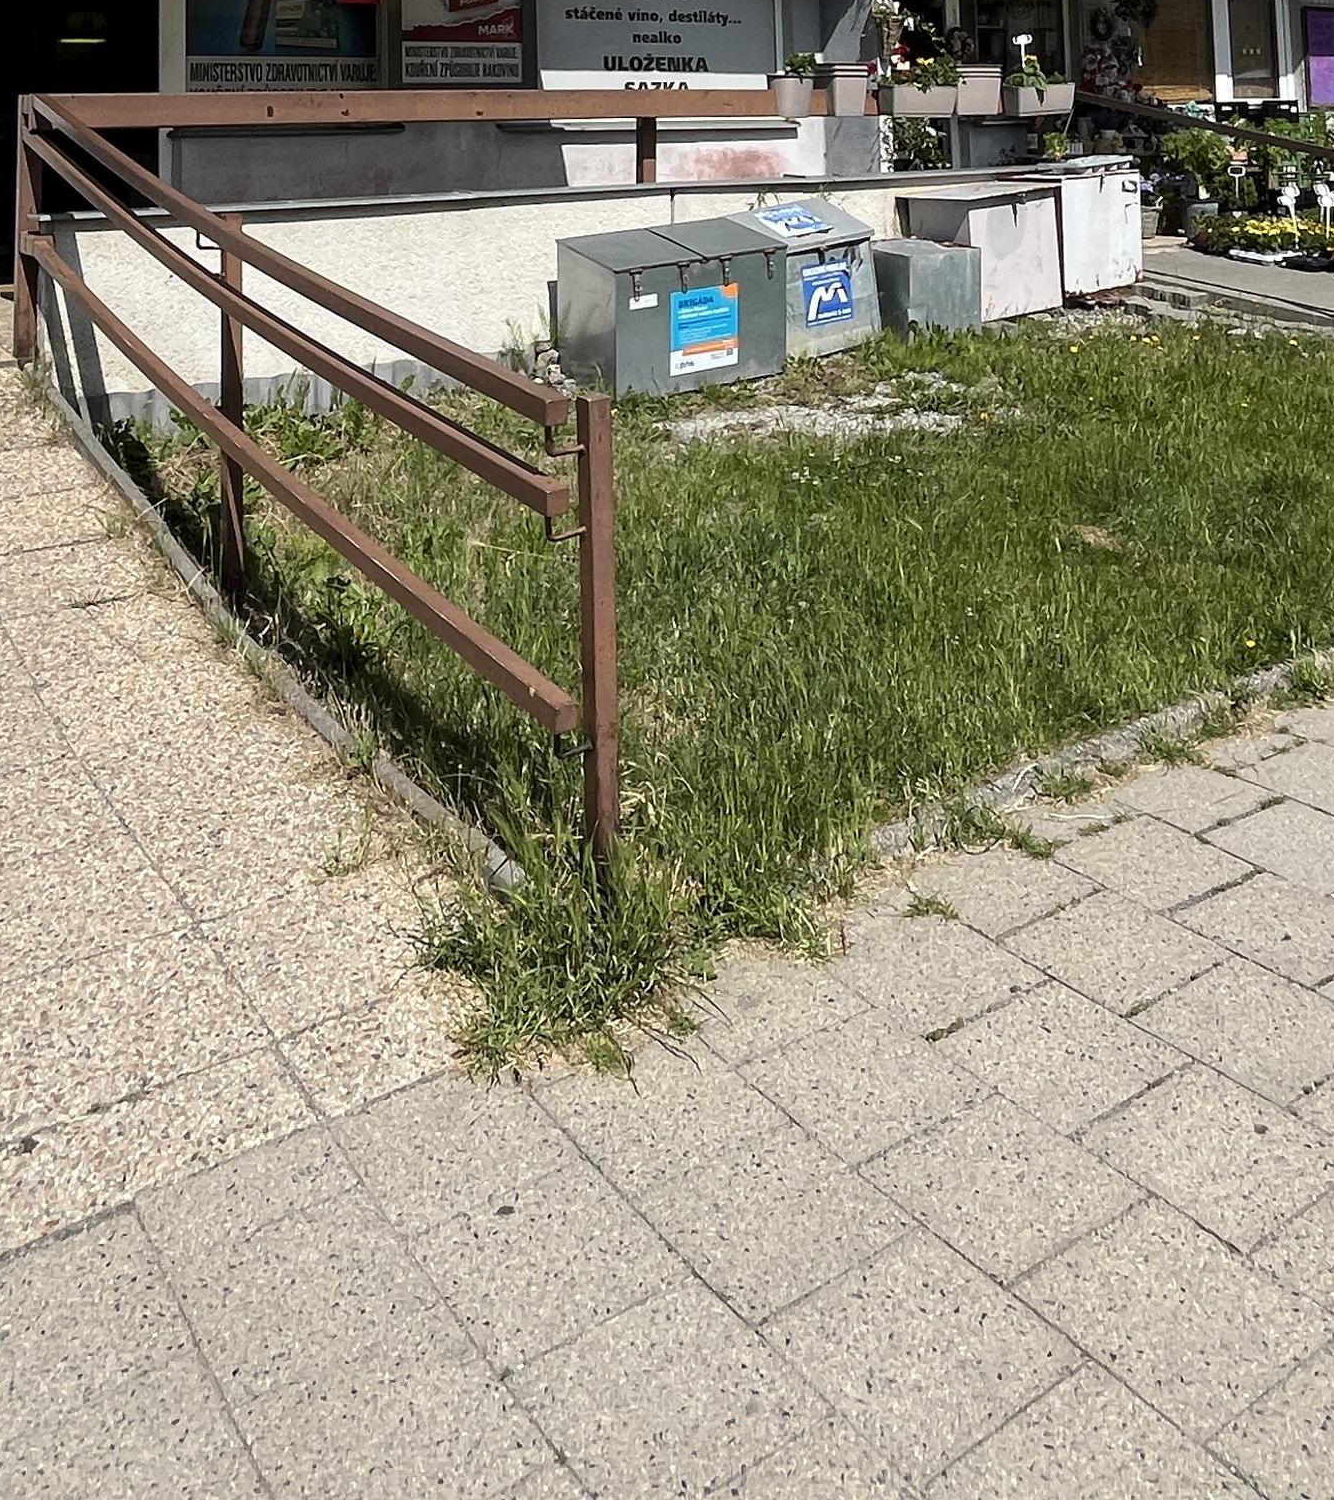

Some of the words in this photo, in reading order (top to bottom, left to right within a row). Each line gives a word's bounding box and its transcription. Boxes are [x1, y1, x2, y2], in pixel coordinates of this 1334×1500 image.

[565, 4, 623, 22] stáčené
[627, 7, 663, 24] víno,
[668, 8, 742, 26] destiláty...
[632, 32, 682, 45] nealko
[190, 63, 263, 82] MINISTERSTVO
[266, 60, 339, 82] ZDRAVOTNICTVÍ
[341, 63, 377, 82] VARUJE
[603, 54, 708, 73] ULOŽENKA
